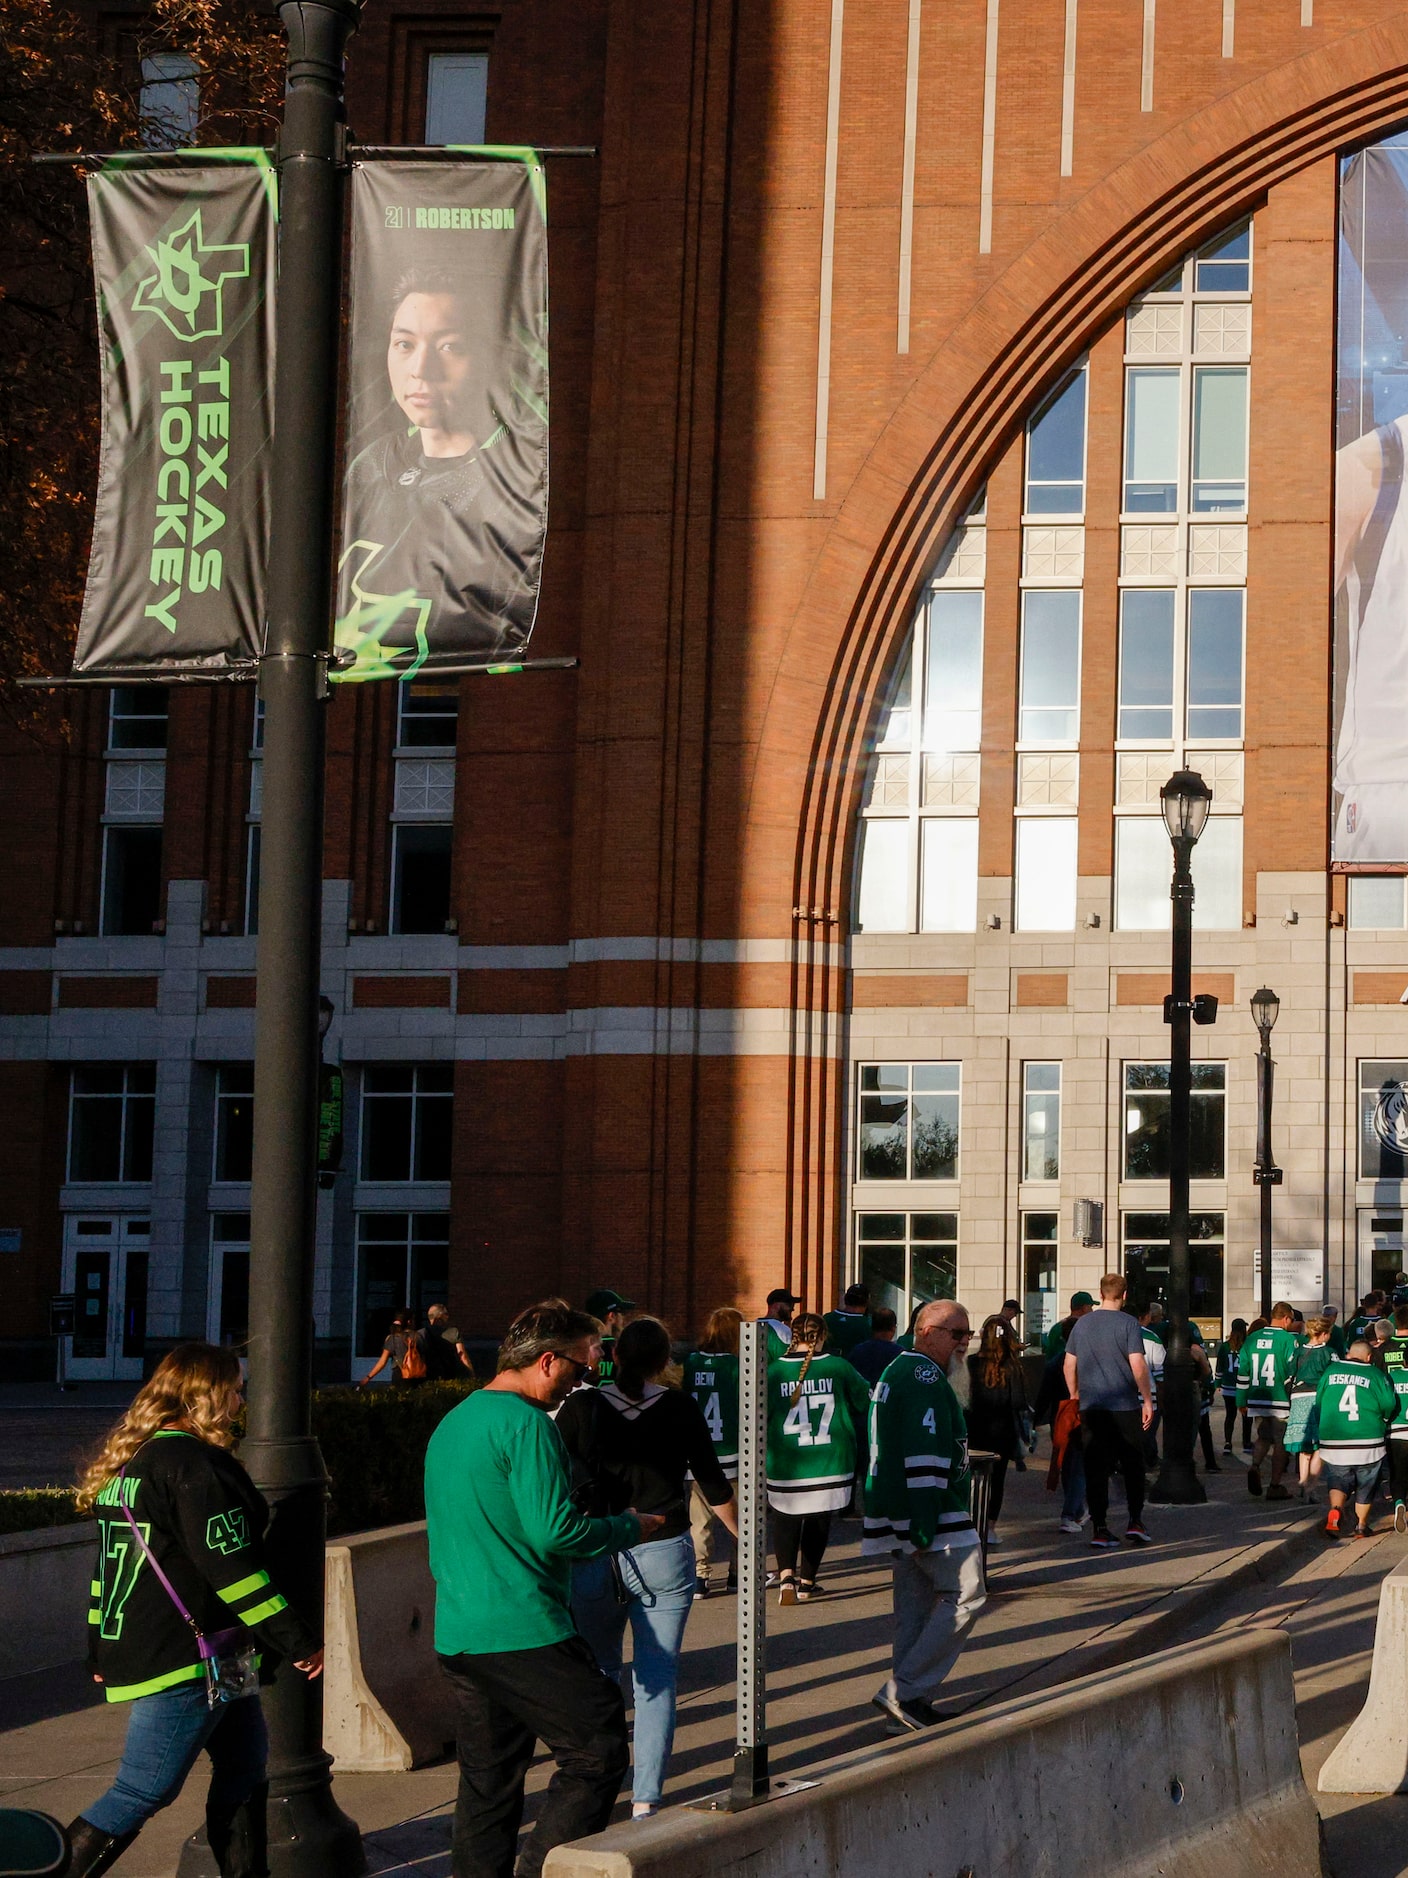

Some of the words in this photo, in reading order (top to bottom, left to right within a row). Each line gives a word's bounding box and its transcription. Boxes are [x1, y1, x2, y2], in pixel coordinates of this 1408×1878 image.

[384, 206, 403, 228] 21
[415, 207, 515, 229] ROBERTSON
[187, 356, 230, 594] TEXAS
[144, 360, 193, 634] HOCKEY
[1251, 1353, 1276, 1387] 14
[1328, 1374, 1370, 1389] HEISKANEN
[783, 1393, 835, 1446] 47
[922, 1407, 937, 1435] 4
[1339, 1384, 1360, 1421] 4
[98, 1519, 152, 1640] 7
